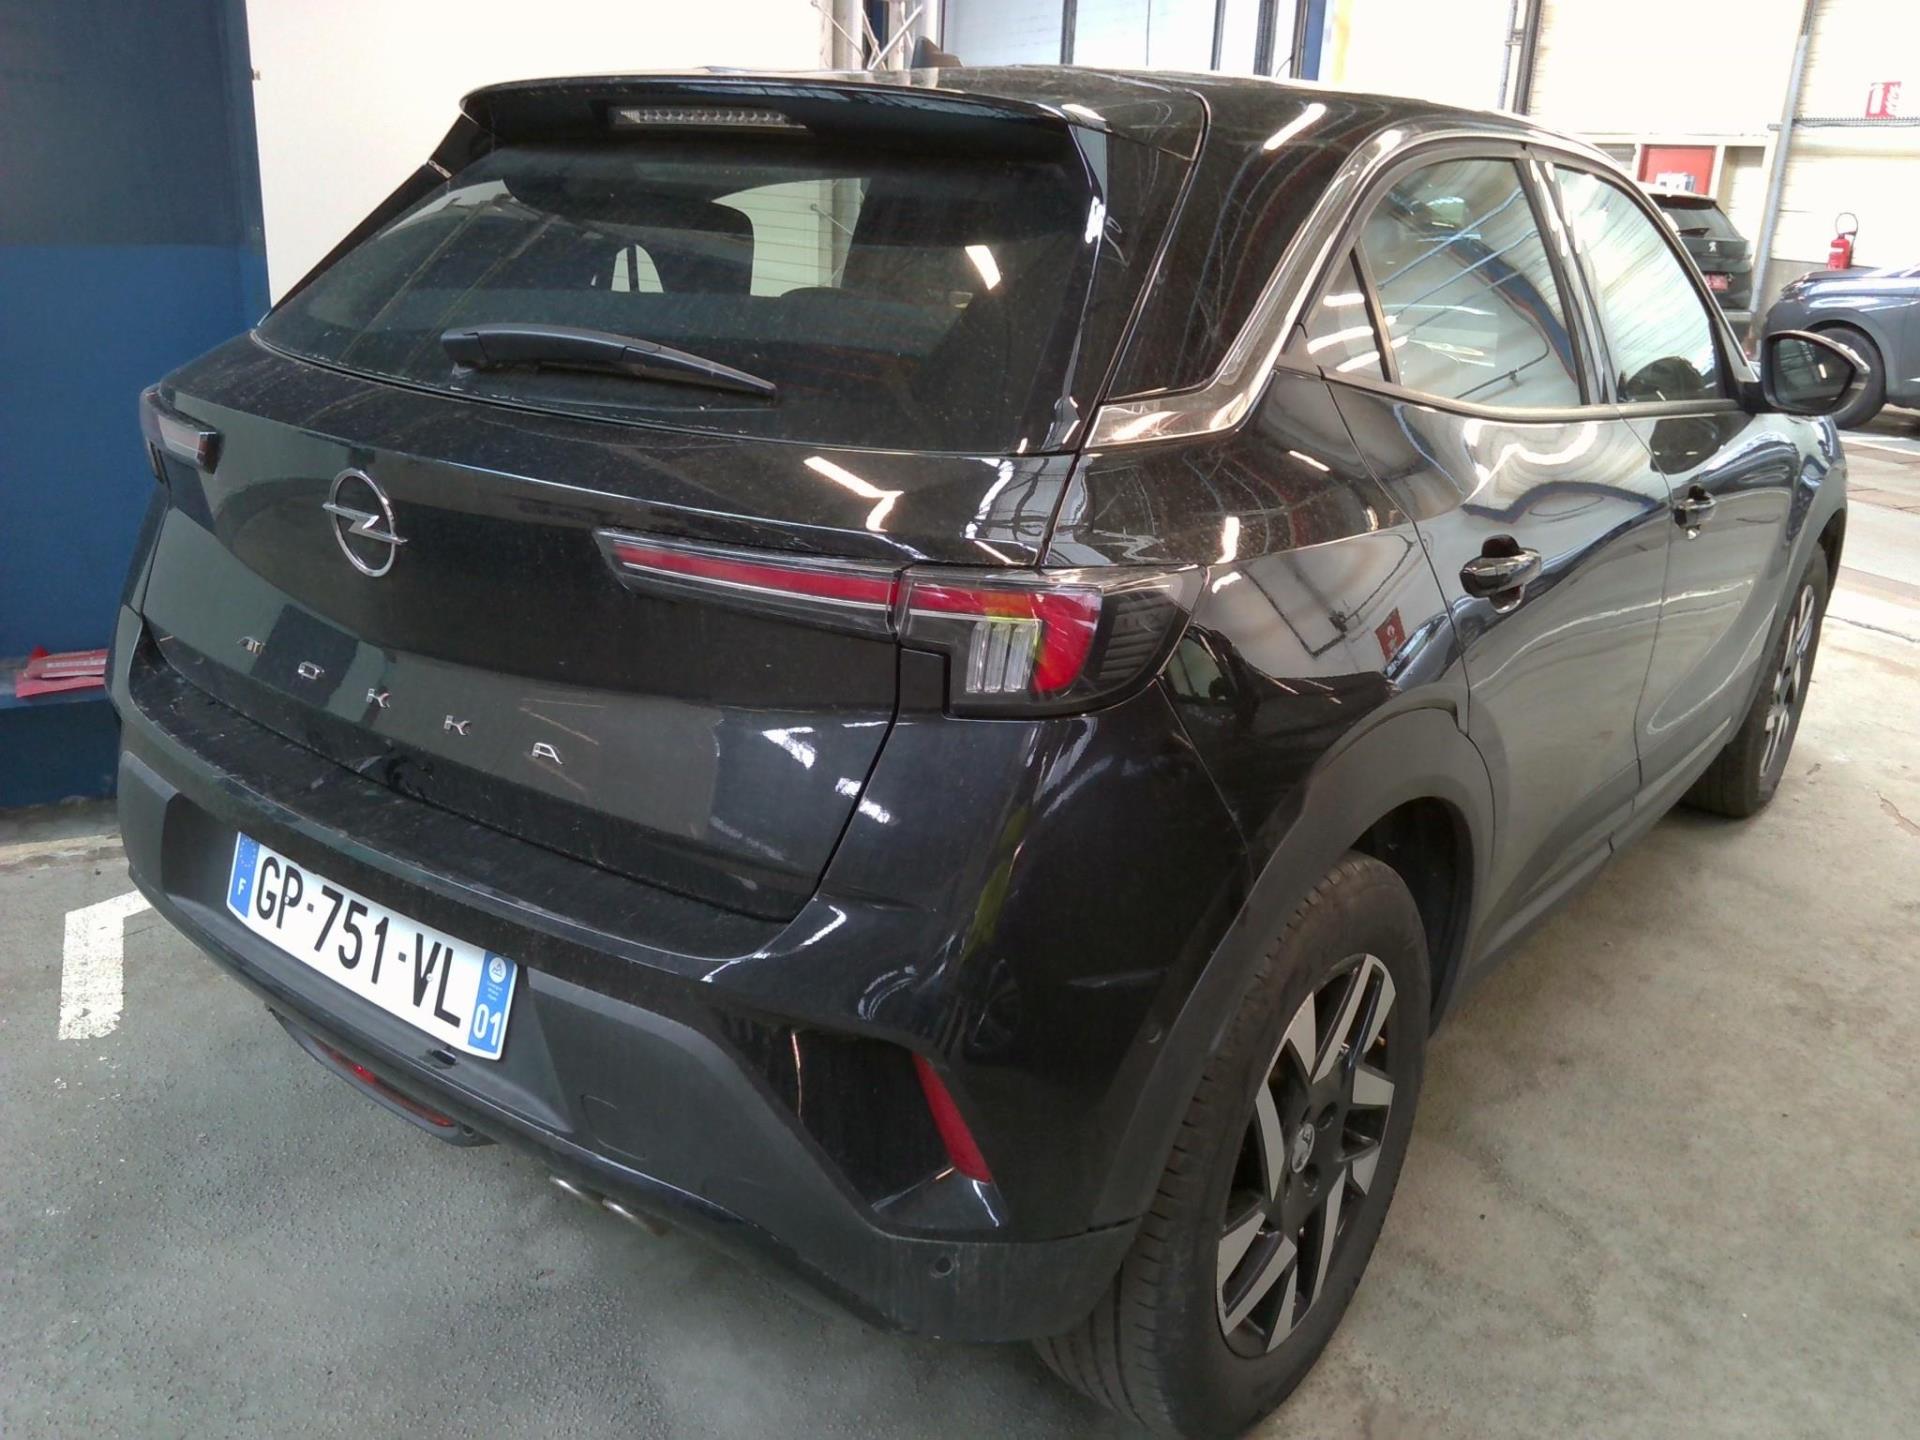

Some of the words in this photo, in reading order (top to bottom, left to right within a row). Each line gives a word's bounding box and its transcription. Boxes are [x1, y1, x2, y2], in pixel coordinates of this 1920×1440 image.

[237, 877, 246, 896] F
[255, 856, 461, 1028] GP-751-VL
[473, 1003, 502, 1046] 01
